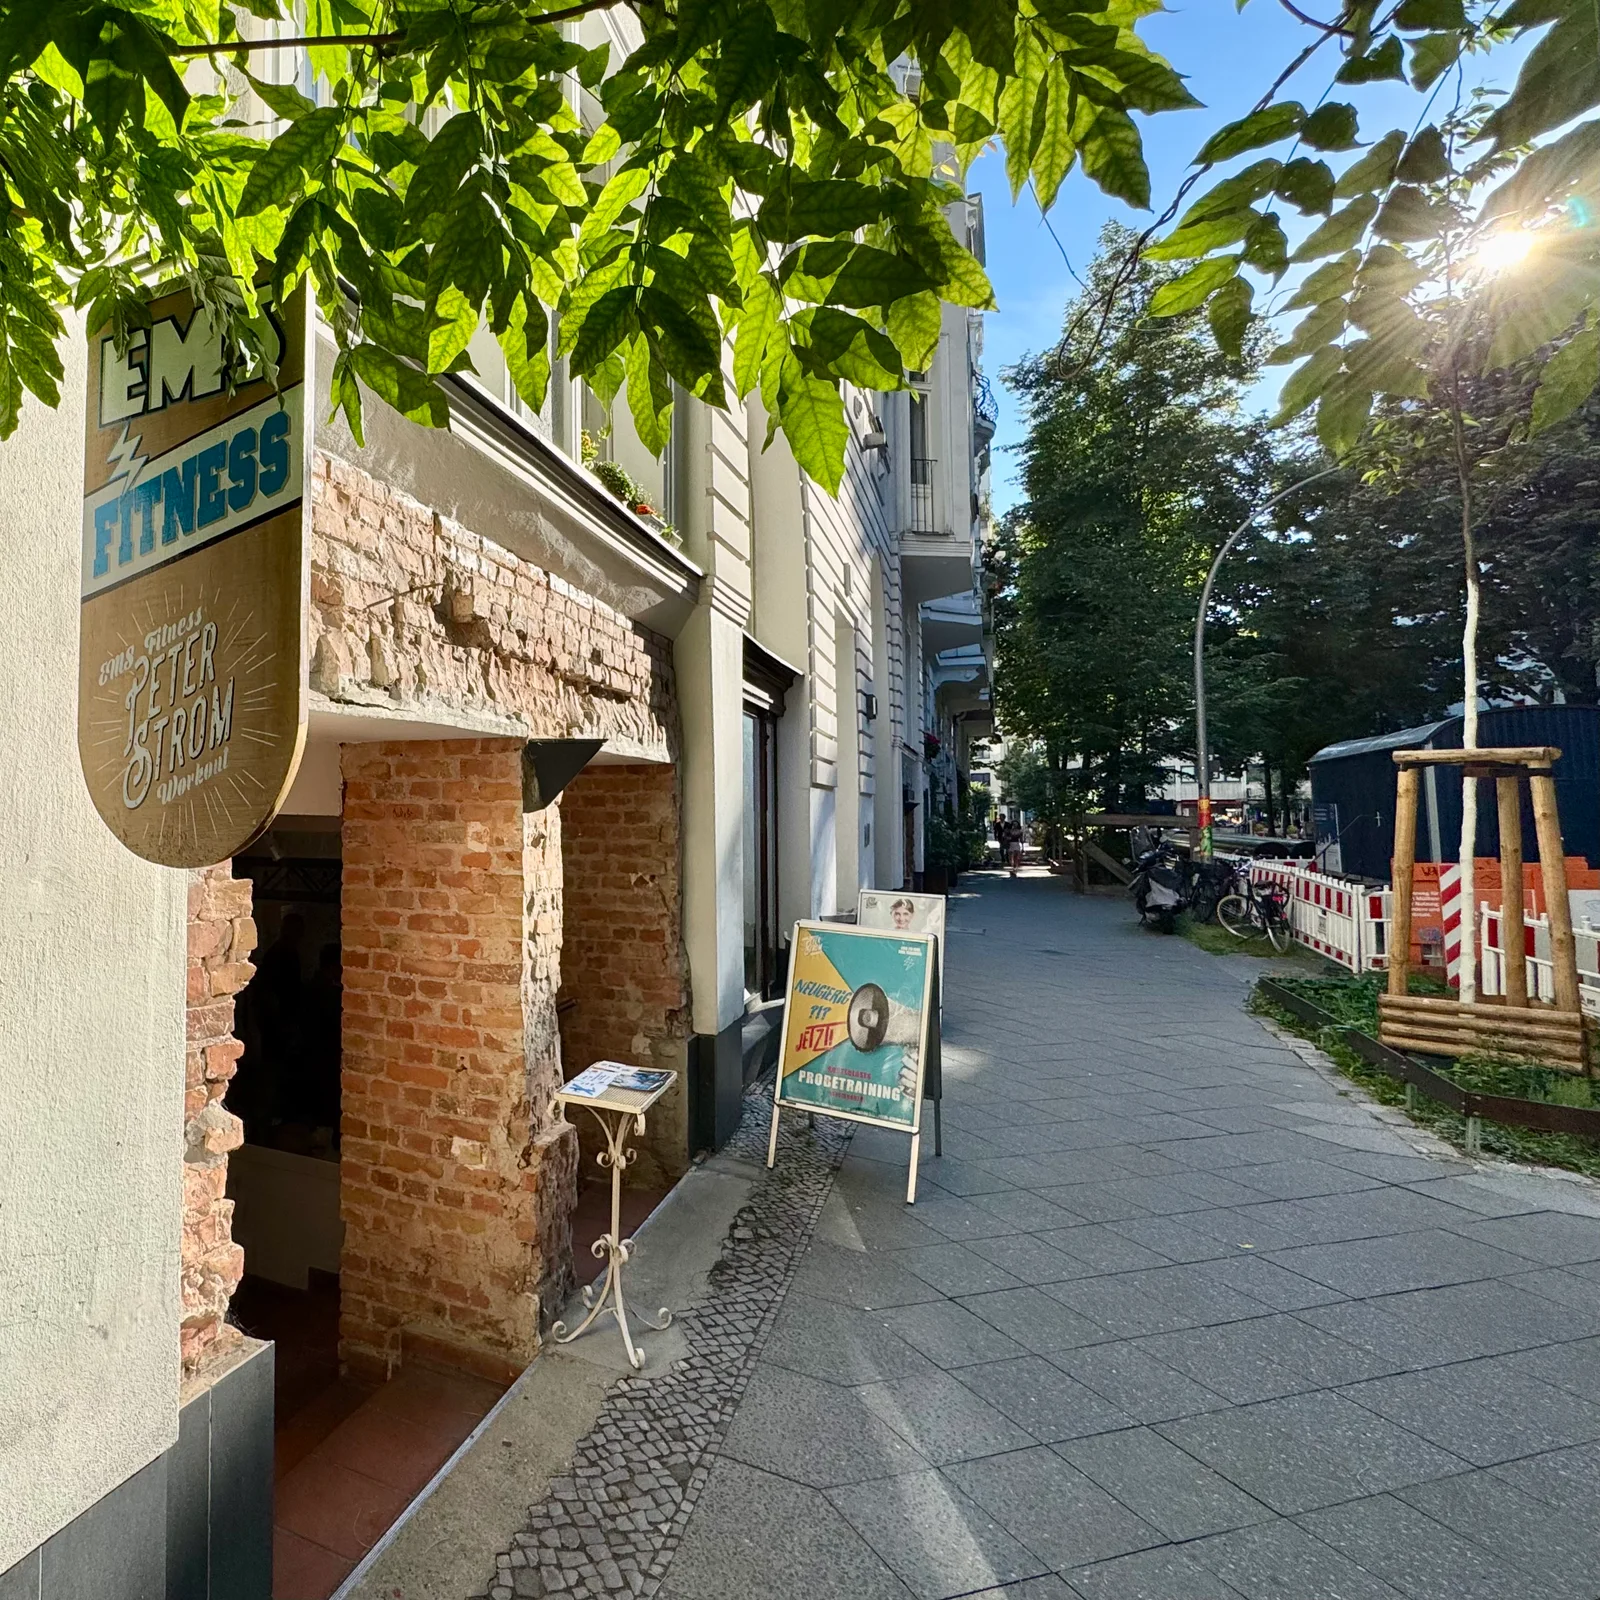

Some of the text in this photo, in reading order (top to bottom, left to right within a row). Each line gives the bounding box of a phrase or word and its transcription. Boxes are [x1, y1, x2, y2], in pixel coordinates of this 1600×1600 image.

[93, 411, 291, 579] FITNESS
[144, 606, 202, 655] Fitness
[124, 621, 218, 757] PETER
[122, 676, 235, 809] STROM
[156, 746, 229, 805] Workout
[795, 979, 852, 1005] NEUGIERIG
[795, 1021, 847, 1052] JETZT!
[798, 1070, 900, 1101] PROBETRAINING
